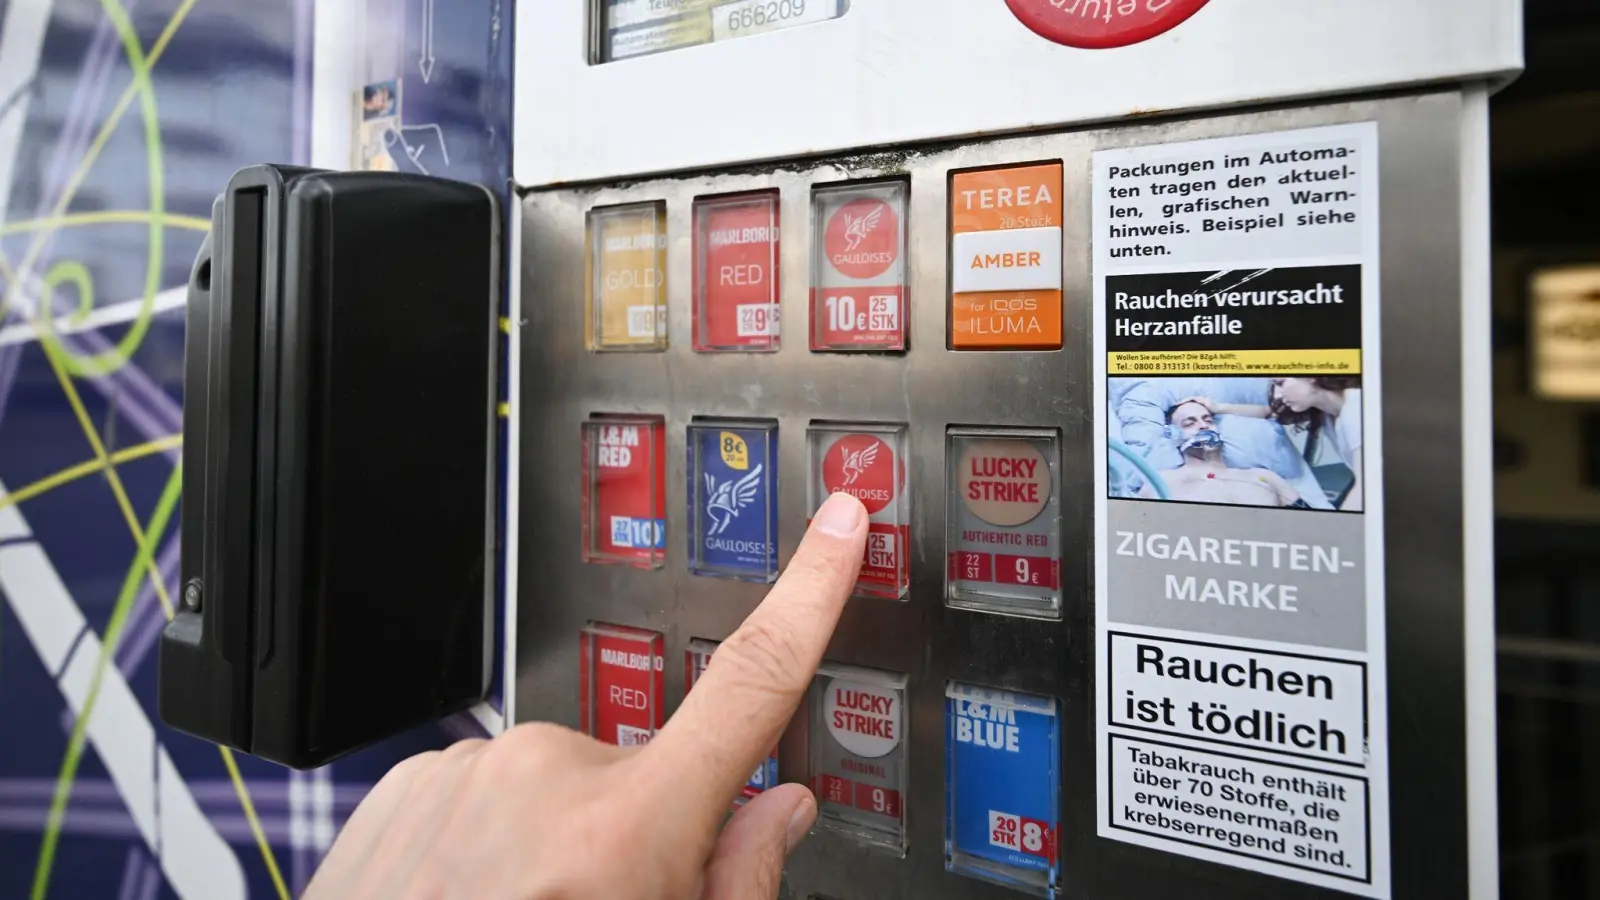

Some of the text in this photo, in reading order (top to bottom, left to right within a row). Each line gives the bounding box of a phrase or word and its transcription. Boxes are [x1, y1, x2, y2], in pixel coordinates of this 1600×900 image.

[728, 1, 805, 31] 666209
[1108, 146, 1356, 180] Packungen im Automa-
[1109, 165, 1356, 199] ten tragen den aktuel-
[961, 184, 1053, 210] TEREA
[1109, 188, 1356, 220] len, grafischen Warn-
[999, 215, 1052, 229] 20 Stück
[1109, 209, 1356, 239] hinweis. Beispiel siehe
[833, 251, 892, 266] GAULOISES
[970, 251, 1041, 269] AMBER
[1109, 242, 1172, 258] unten.
[606, 267, 664, 291] GOLD
[720, 264, 763, 287] RED
[871, 298, 887, 311] 25
[970, 298, 1038, 313] for IQOS
[1115, 283, 1344, 311] Rauchen verursacht
[825, 296, 867, 332] 10€
[871, 313, 895, 329] STK
[970, 315, 1042, 334] ILUMA
[1115, 314, 1243, 338] Herzanfälle
[1116, 363, 1132, 371] Tel.:
[1162, 362, 1190, 370] 313131
[1151, 352, 1185, 361] aufhören?
[1186, 352, 1198, 360] Die
[1200, 352, 1218, 362] BZgA
[599, 425, 639, 446] L&M
[598, 446, 632, 468] RED
[970, 456, 1039, 479] LUCKY
[967, 480, 1040, 504] STRIKE
[705, 536, 775, 556] GAULOISES
[870, 534, 886, 549] 25
[962, 530, 1048, 547] AUTHENTIC RED
[871, 551, 894, 567] STK
[966, 553, 979, 567] 22
[1115, 530, 1356, 575] ZIGARETTEN-
[967, 566, 980, 580] ST
[1164, 574, 1299, 612] MARKE
[1136, 643, 1334, 700] Rauchen
[609, 685, 648, 710] RED
[836, 688, 894, 716] LUCKY
[956, 688, 1016, 726] L&M
[833, 710, 894, 740] STRIKE
[1126, 690, 1347, 754] ist tödlich
[956, 718, 1020, 753] BLUE
[840, 758, 887, 779] ORIGINAL
[1127, 746, 1347, 802] Tabakrauch enthält
[829, 777, 843, 790] 22
[1132, 768, 1341, 822] über 70 Stoffe, die
[996, 816, 1017, 833] 20
[1134, 789, 1339, 844] erwiesenermaßen
[993, 830, 1016, 847] STK
[1123, 805, 1353, 868] krebserregend sind.
